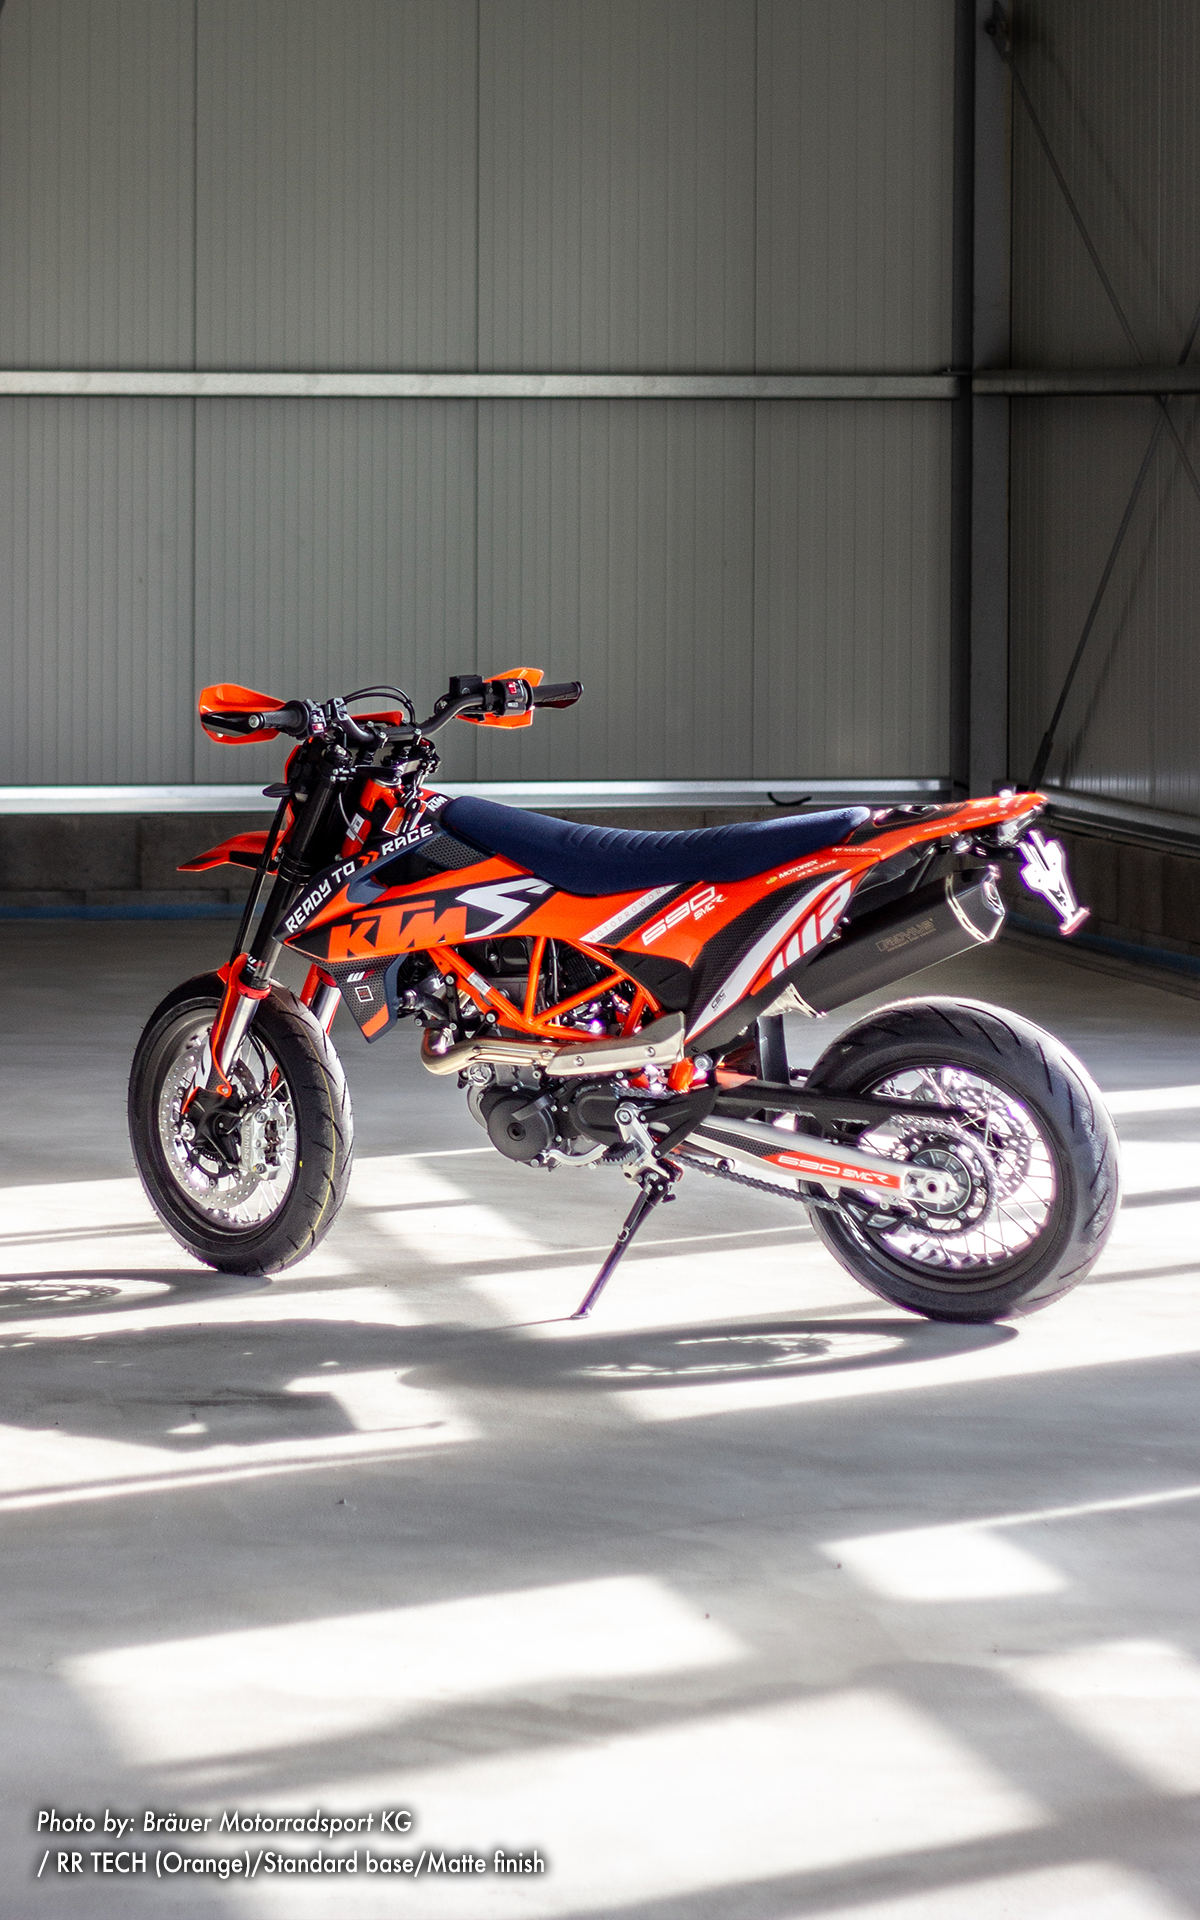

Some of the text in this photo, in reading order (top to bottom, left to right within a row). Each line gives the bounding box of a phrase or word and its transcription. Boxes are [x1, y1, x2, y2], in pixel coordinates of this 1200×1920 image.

[285, 879, 332, 933] READY
[331, 861, 356, 883] TO
[381, 823, 434, 856] RACE
[778, 859, 819, 879] MOTOREX
[328, 900, 467, 961] KTM
[641, 885, 715, 947] 690
[778, 1155, 840, 1175] 690
